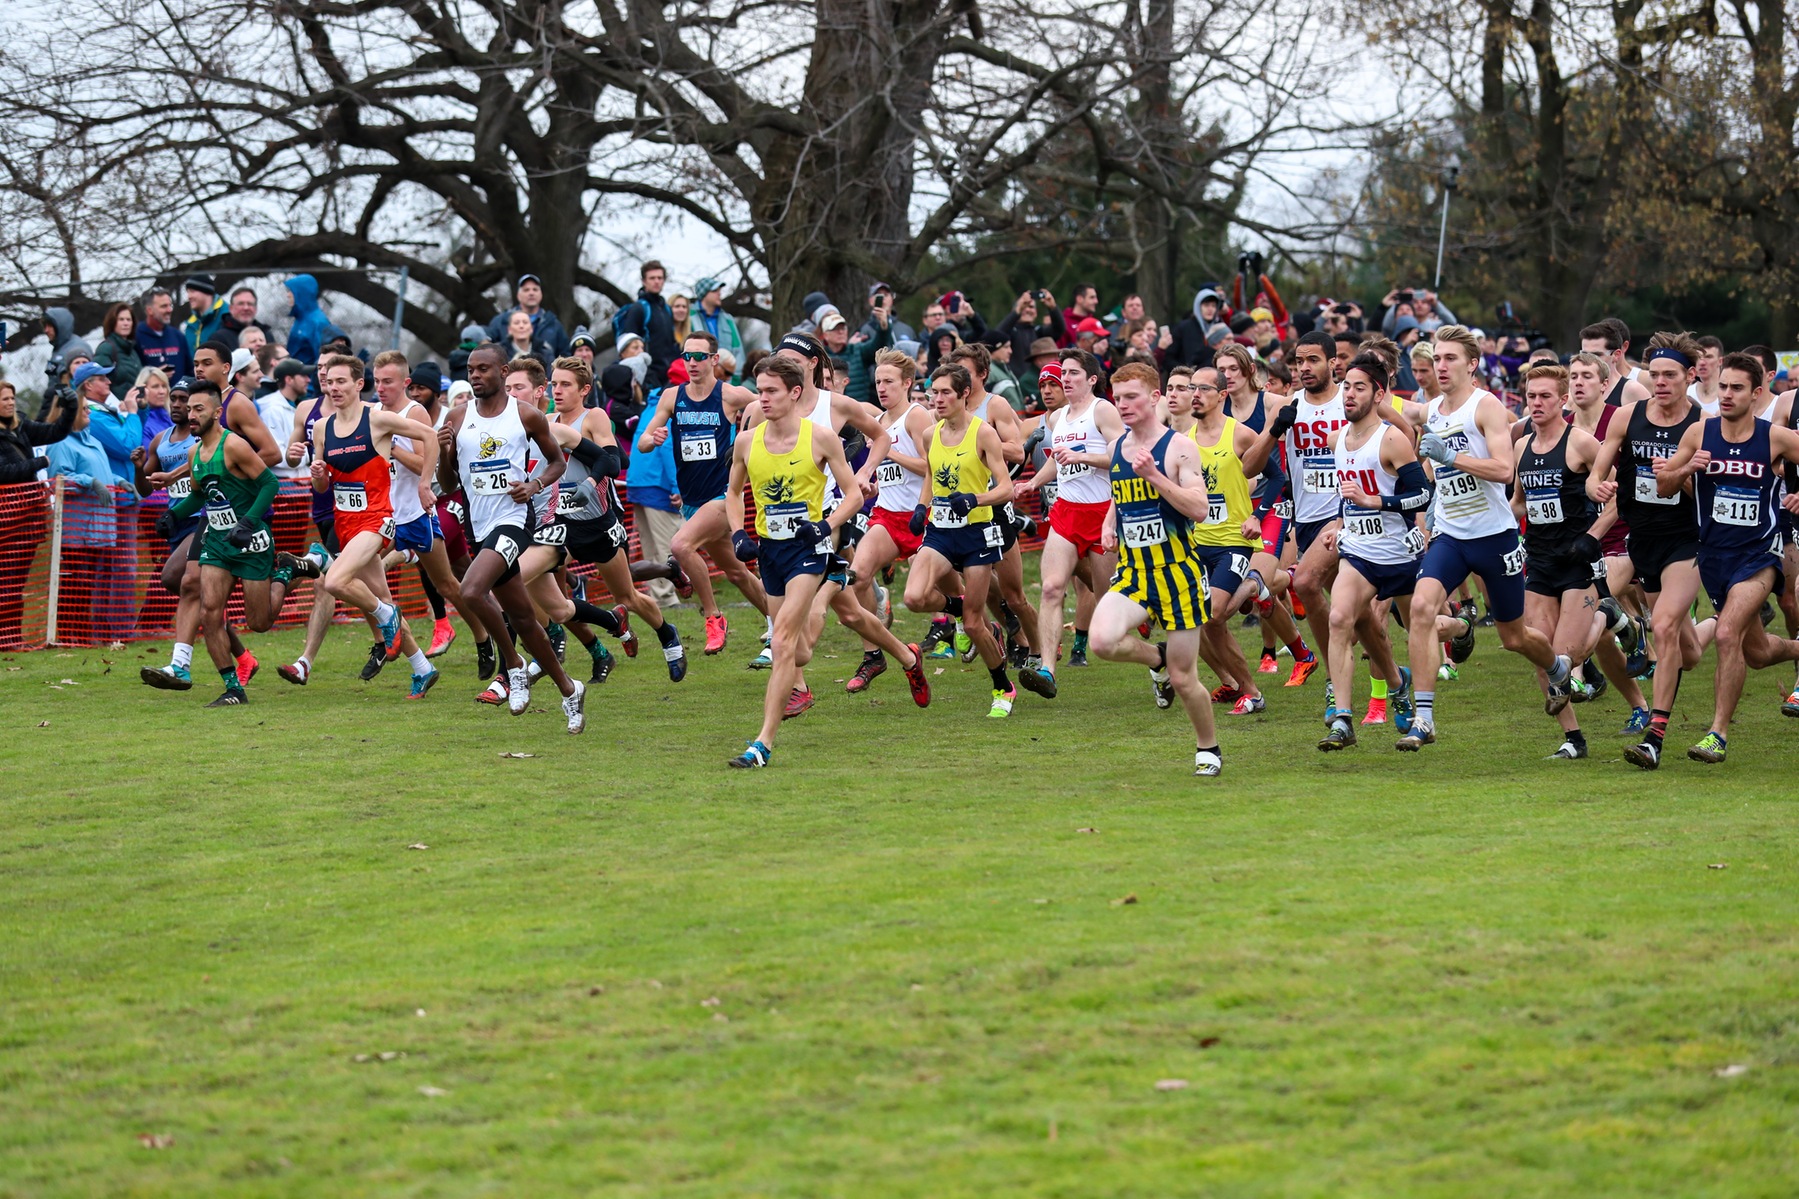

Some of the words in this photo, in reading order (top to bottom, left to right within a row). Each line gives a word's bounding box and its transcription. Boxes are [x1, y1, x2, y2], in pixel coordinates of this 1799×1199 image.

[676, 411, 721, 426] AUGUSTA
[1054, 432, 1087, 444] SVSU
[697, 442, 711, 456] 33
[1295, 447, 1334, 458] PUEB
[1631, 445, 1678, 459] MINE
[159, 453, 188, 463] NORTHWO
[883, 464, 902, 482] 204
[1705, 460, 1765, 479] DBU
[175, 478, 191, 495] 188
[490, 473, 508, 490] 26
[1319, 472, 1339, 488] 11
[1449, 475, 1477, 497] 199
[1520, 473, 1563, 488] MINES
[349, 494, 362, 508] 66
[560, 495, 576, 510] 32
[217, 511, 236, 526] 181
[1209, 506, 1221, 520] 47
[1542, 502, 1557, 519] 98
[1730, 502, 1758, 521] 113
[534, 525, 565, 544] 322
[1136, 522, 1162, 542] 247
[1358, 518, 1382, 536] 108
[249, 532, 269, 552] 81
[502, 539, 519, 563] 26
[1507, 549, 1525, 573] 19
